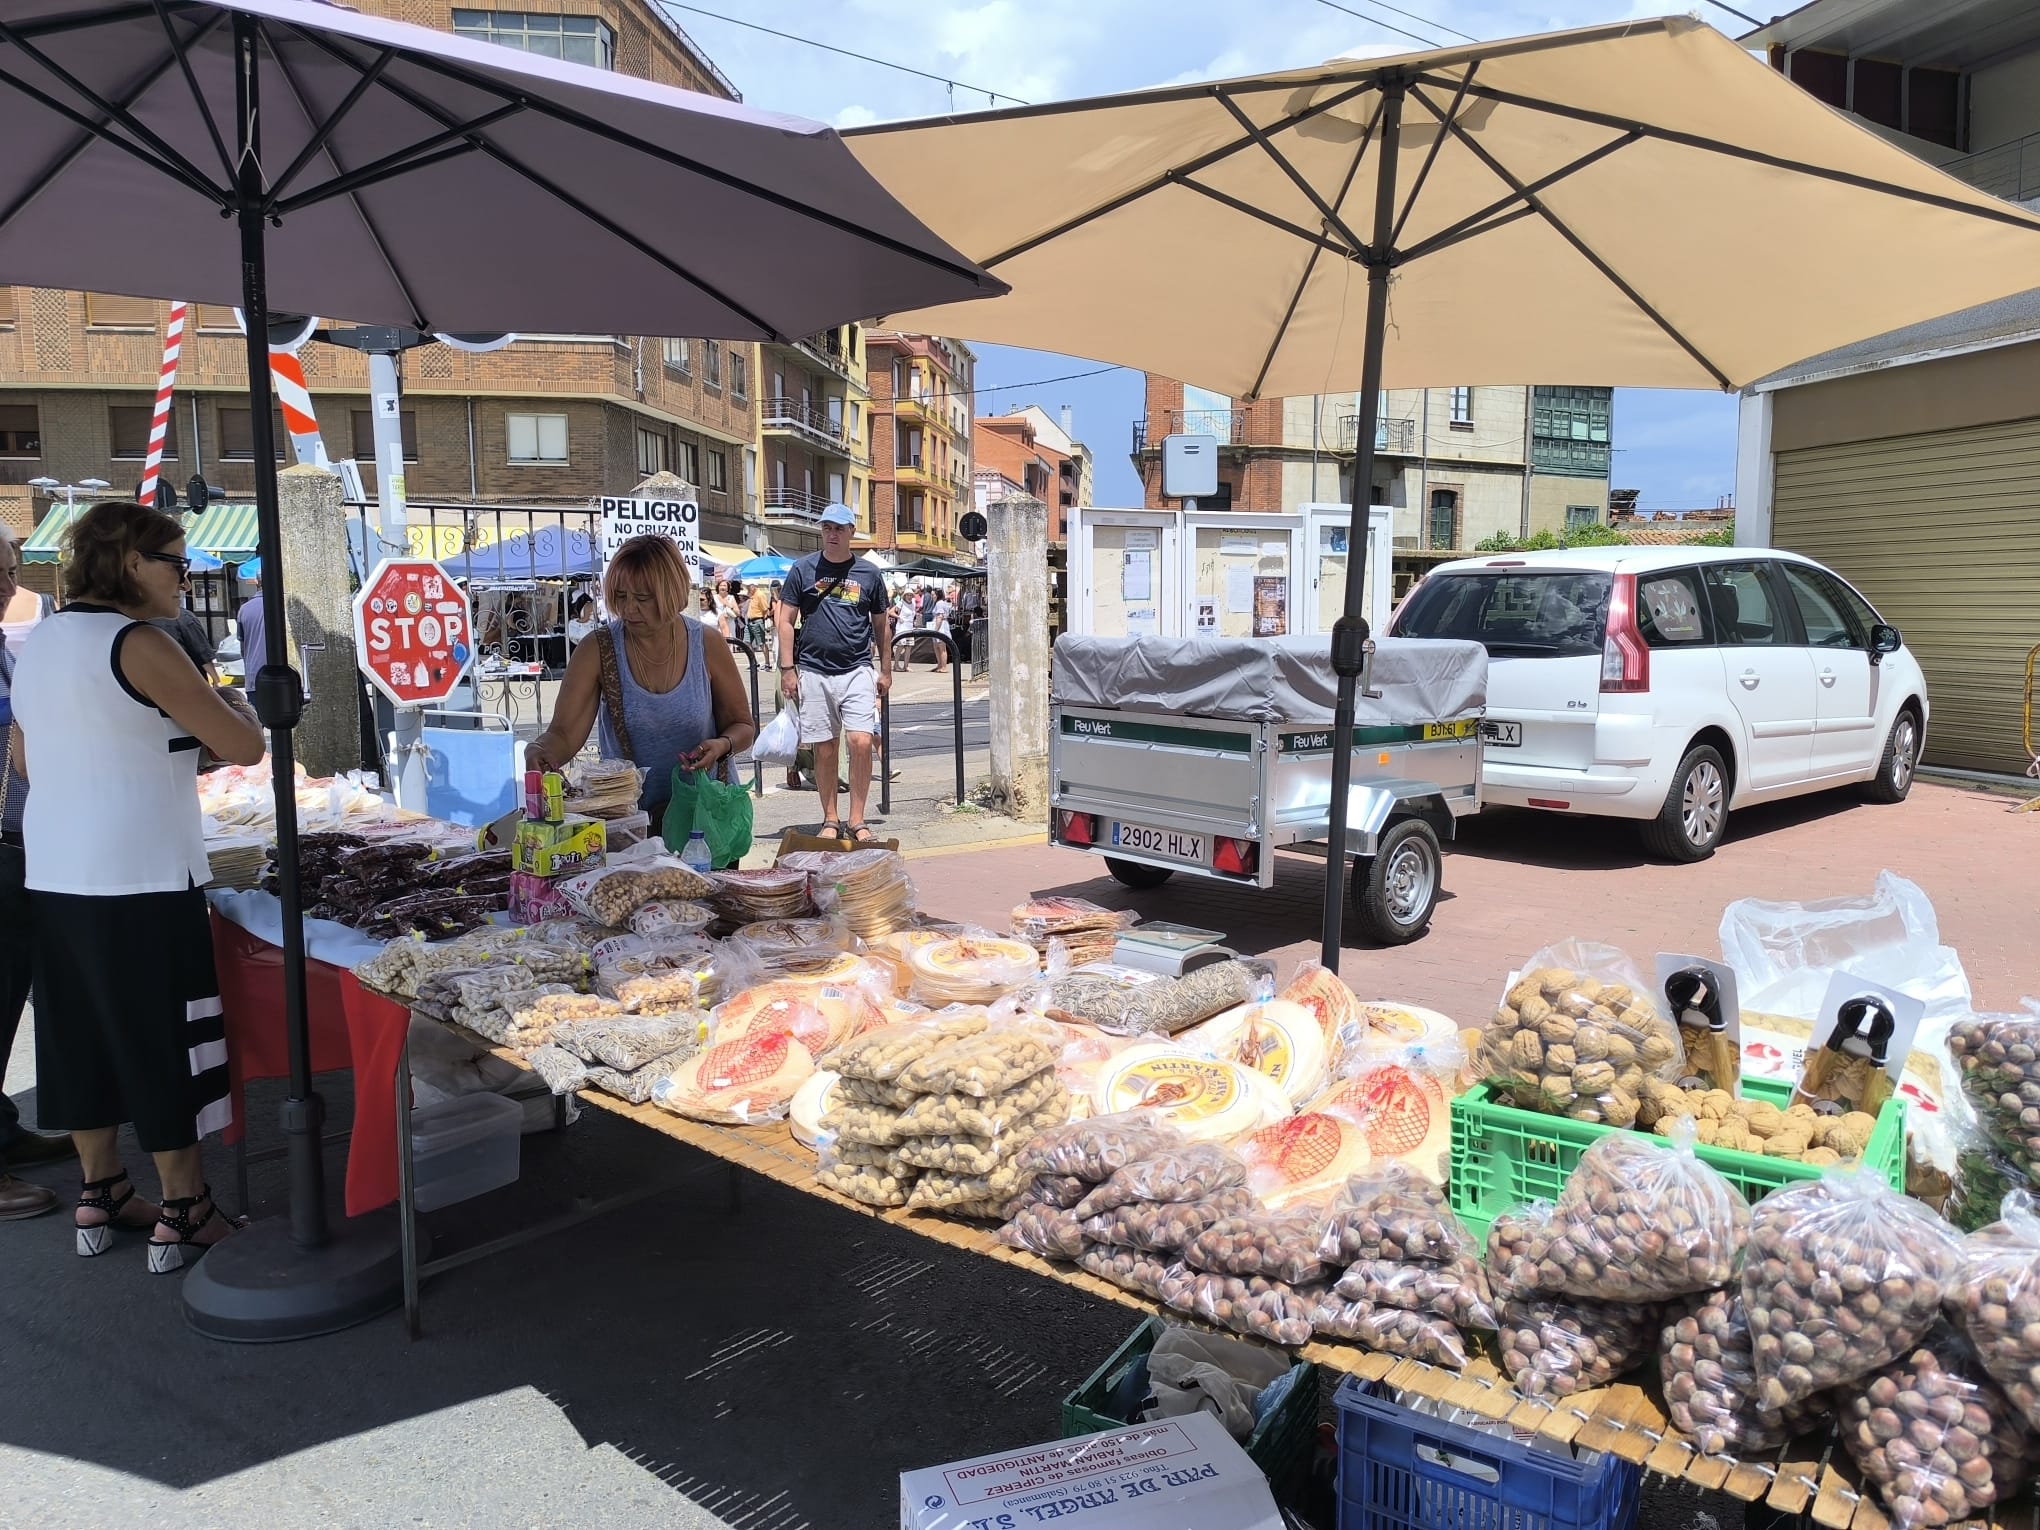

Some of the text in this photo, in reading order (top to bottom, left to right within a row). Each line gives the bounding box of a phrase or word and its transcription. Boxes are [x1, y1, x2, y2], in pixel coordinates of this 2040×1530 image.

[603, 499, 696, 523] PELIGRO
[614, 523, 687, 537] NO CRUZAR
[369, 615, 463, 652] STOP
[1074, 719, 1112, 735] Feu Vert
[1293, 733, 1328, 749] Feu Vert
[1122, 826, 1200, 859] 2902 HLX
[1101, 1436, 1121, 1448] 150
[1125, 1433, 1140, 1443] de
[1142, 1427, 1169, 1440] más
[957, 1454, 1045, 1480] ANTIGÜEDAD
[1019, 1447, 1124, 1477] FABIAN MARTIN
[1048, 1450, 1065, 1460] de
[984, 1447, 1167, 1496] Obleas famosas de CIPEREZ
[1161, 1463, 1220, 1487] PAN
[1002, 1463, 1169, 1509] Tfno. 923 51 80 79 (Salamanca)
[1120, 1478, 1161, 1498] DE
[1019, 1488, 1119, 1522] ANGEL,
